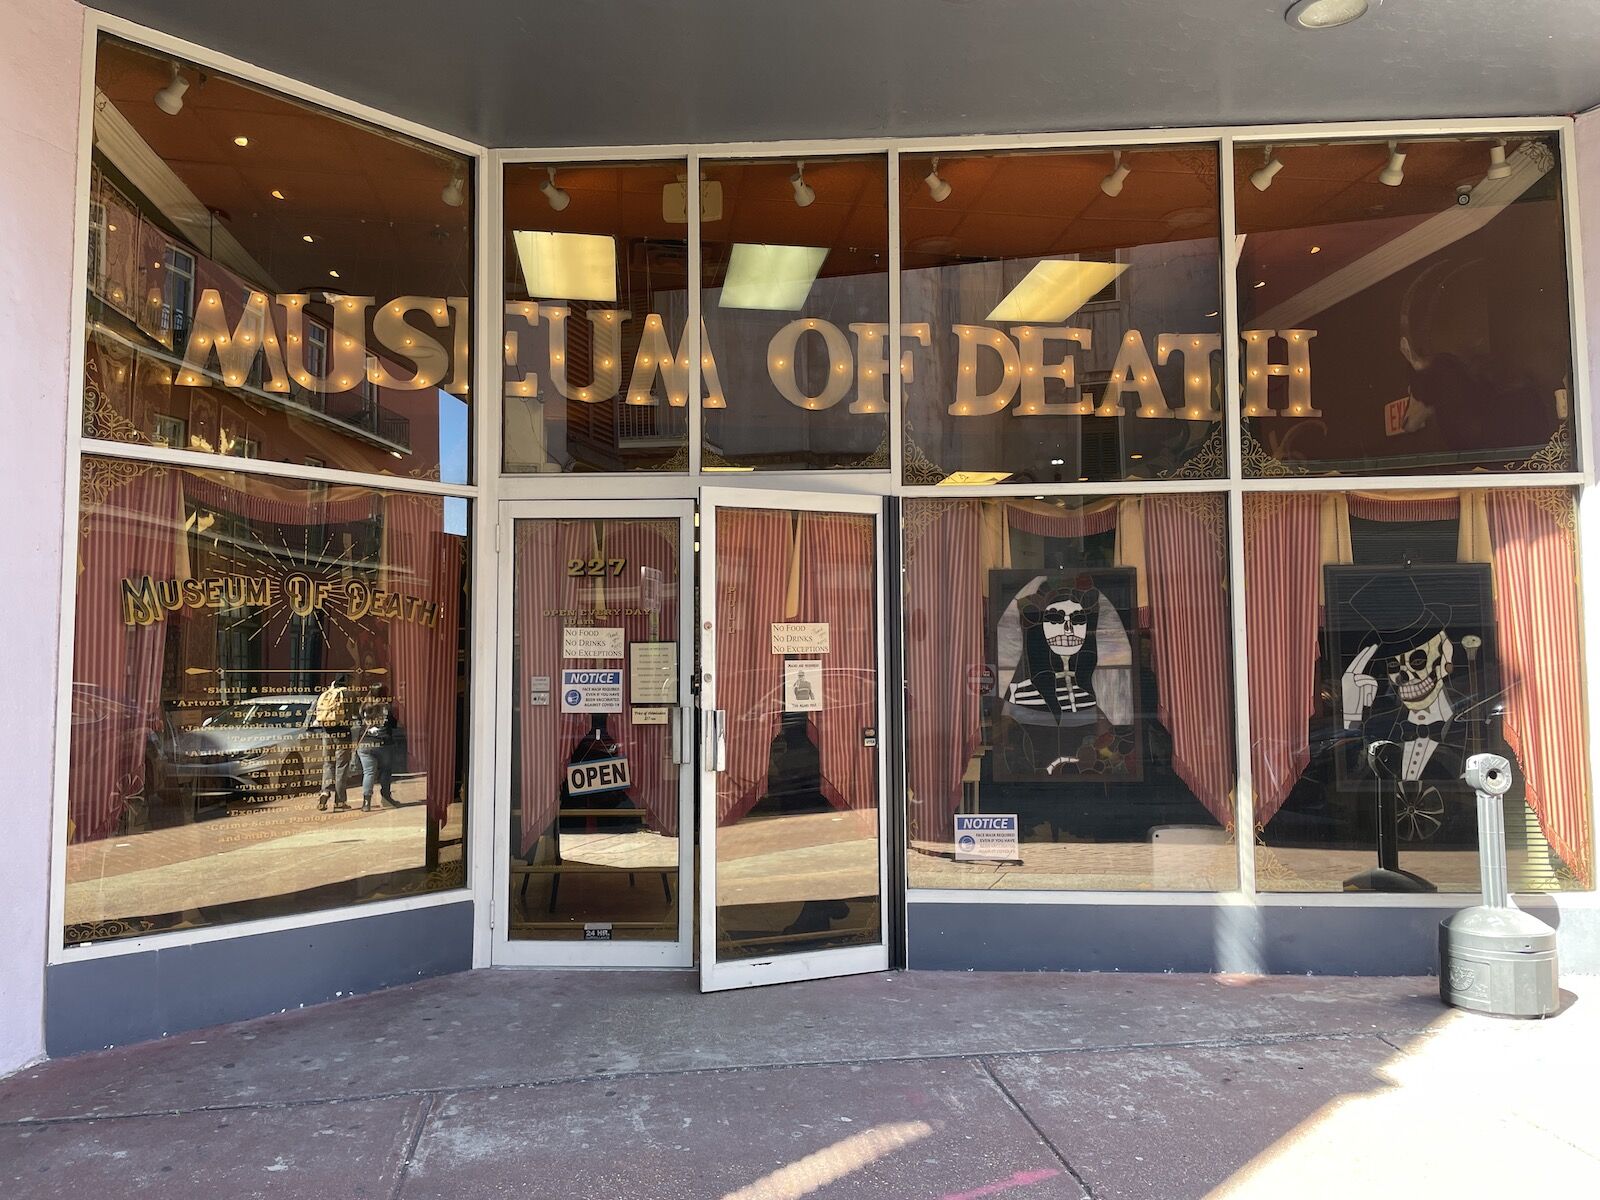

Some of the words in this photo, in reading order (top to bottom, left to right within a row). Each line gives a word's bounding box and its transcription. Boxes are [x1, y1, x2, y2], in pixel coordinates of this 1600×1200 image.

[174, 288, 727, 409] MUSEUM
[766, 317, 930, 414] OF
[948, 323, 1323, 420] DEATH
[567, 558, 627, 577] 227
[121, 575, 272, 626] MUSEUM
[284, 572, 330, 617] OF
[344, 579, 438, 629] DEATH
[543, 609, 577, 617] OPEN
[580, 608, 621, 616] EVERY
[625, 608, 651, 616] DAY
[570, 673, 614, 683] NOTICE
[261, 685, 311, 693] Skeleton
[177, 699, 230, 707] Artwork
[571, 762, 627, 789] OPEN
[290, 780, 302, 788] of
[963, 818, 1009, 829] NOTICE
